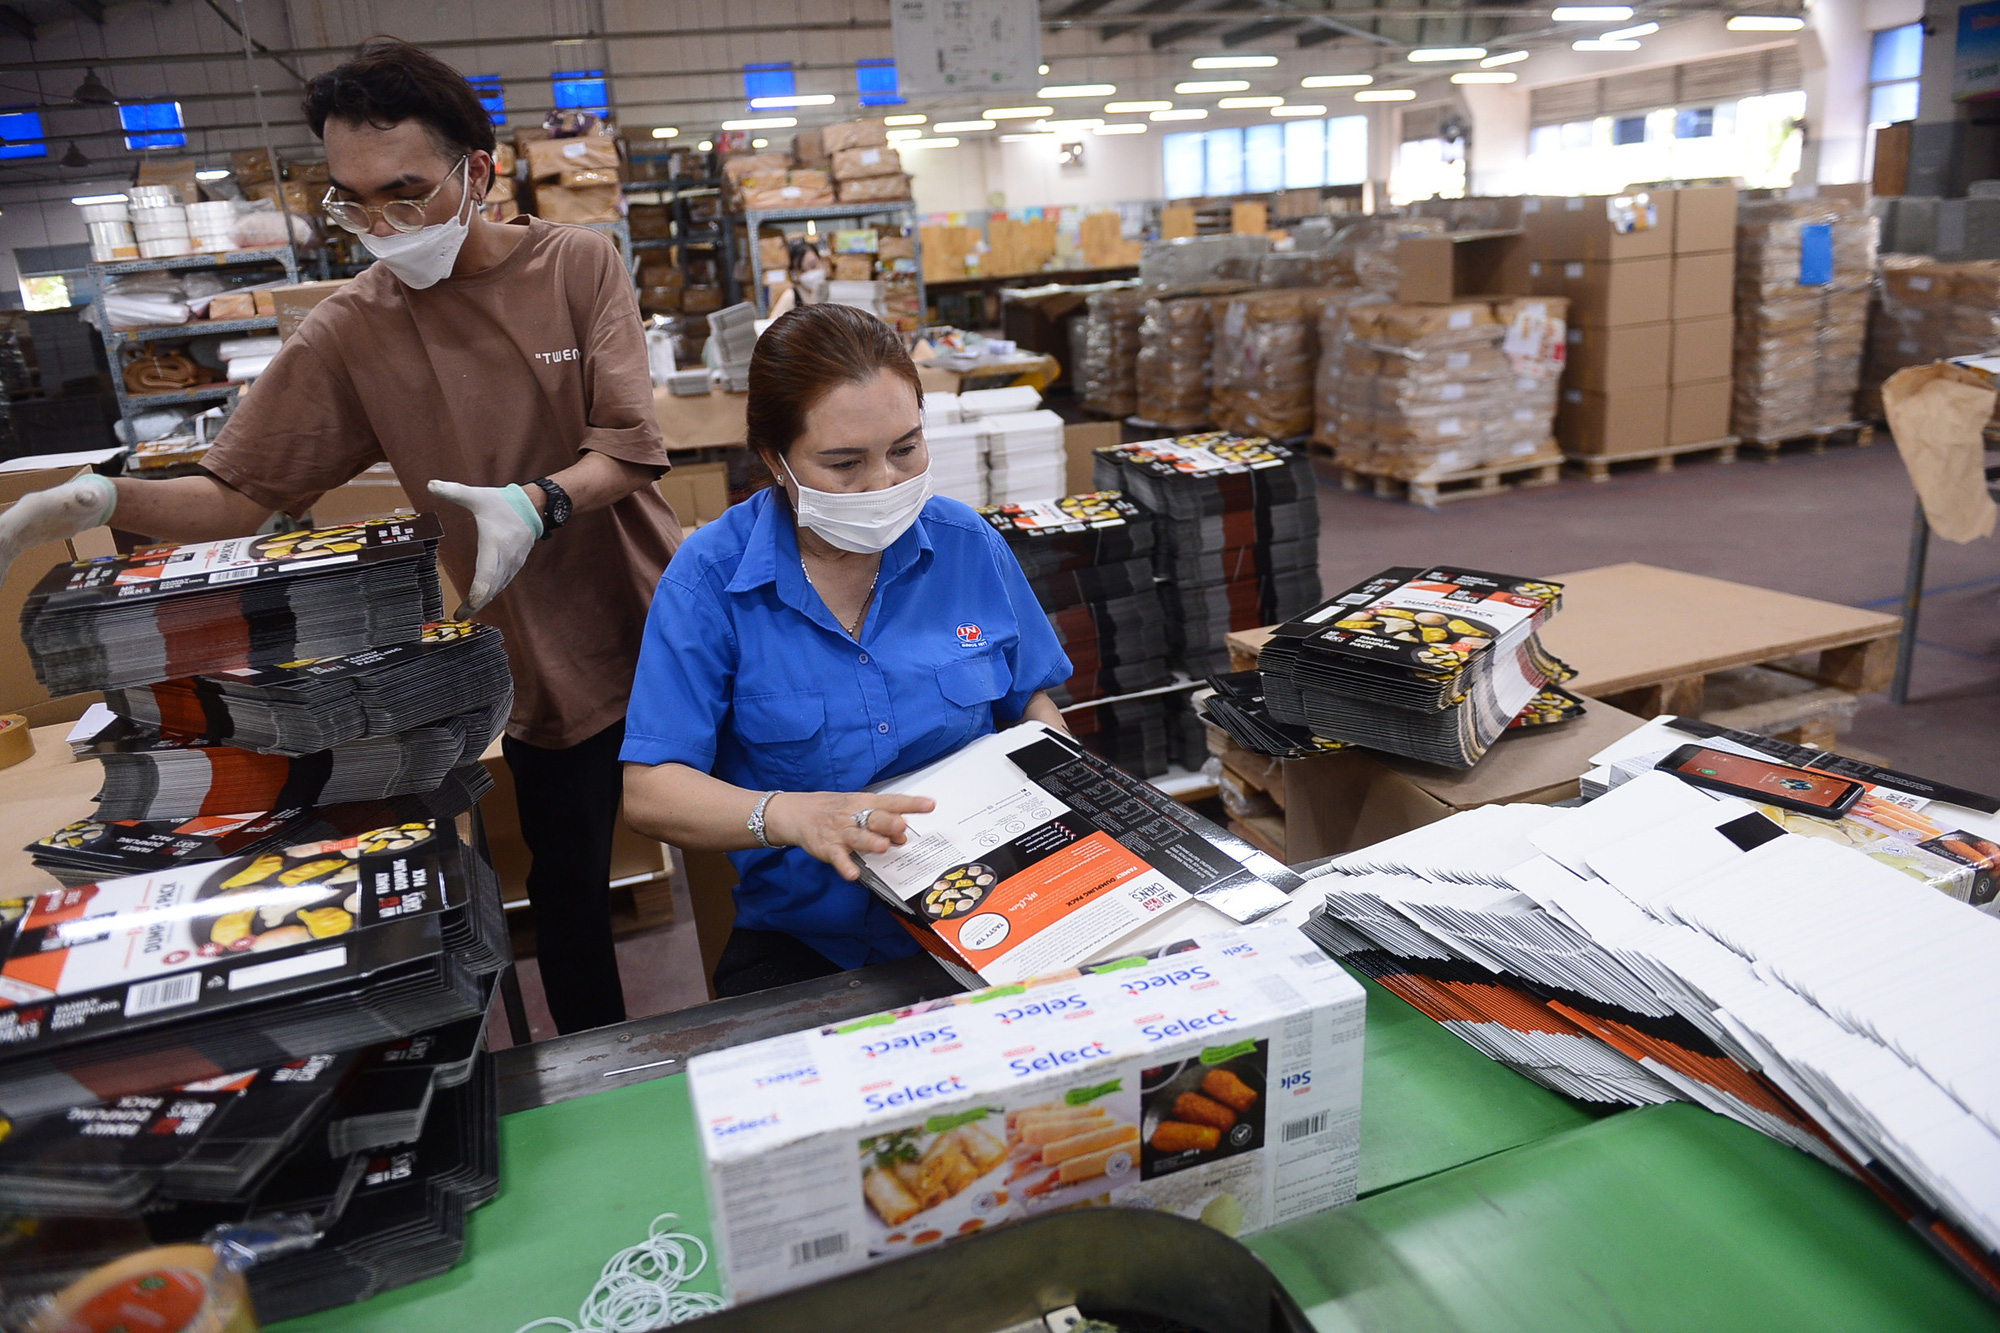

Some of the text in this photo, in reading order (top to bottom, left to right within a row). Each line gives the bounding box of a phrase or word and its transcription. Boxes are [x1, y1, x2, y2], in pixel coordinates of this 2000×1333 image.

[1402, 599, 1495, 618] DUMPLING PACK
[1433, 600, 1473, 609] FAMILY
[1348, 641, 1374, 650] PACK
[1353, 638, 1400, 651] DUMPLING
[1359, 635, 1391, 644] FAMILY
[116, 836, 165, 849] DUMPLING
[119, 844, 155, 854] FAMILY
[147, 834, 176, 842] PACK
[375, 872, 391, 895] FAMILY
[392, 858, 410, 891] DUMPLING
[412, 868, 428, 888] PACK
[156, 881, 178, 909] PACK
[1064, 865, 1139, 907] FAMILY DUMPLING PACK
[1127, 880, 1179, 904] MR CHEN'S
[972, 921, 1006, 946] TASTY TIP
[1120, 965, 1211, 997] Select
[994, 993, 1089, 1027] Select
[1141, 1008, 1238, 1045] Select
[860, 1025, 958, 1059] Select
[1009, 1040, 1112, 1079] Select
[753, 1066, 819, 1088] Select
[117, 1095, 164, 1110] PACK
[864, 1076, 967, 1115] Select
[67, 1107, 151, 1124] DUMPLING
[712, 1113, 780, 1139] Select
[79, 1122, 141, 1137] FAMILY
